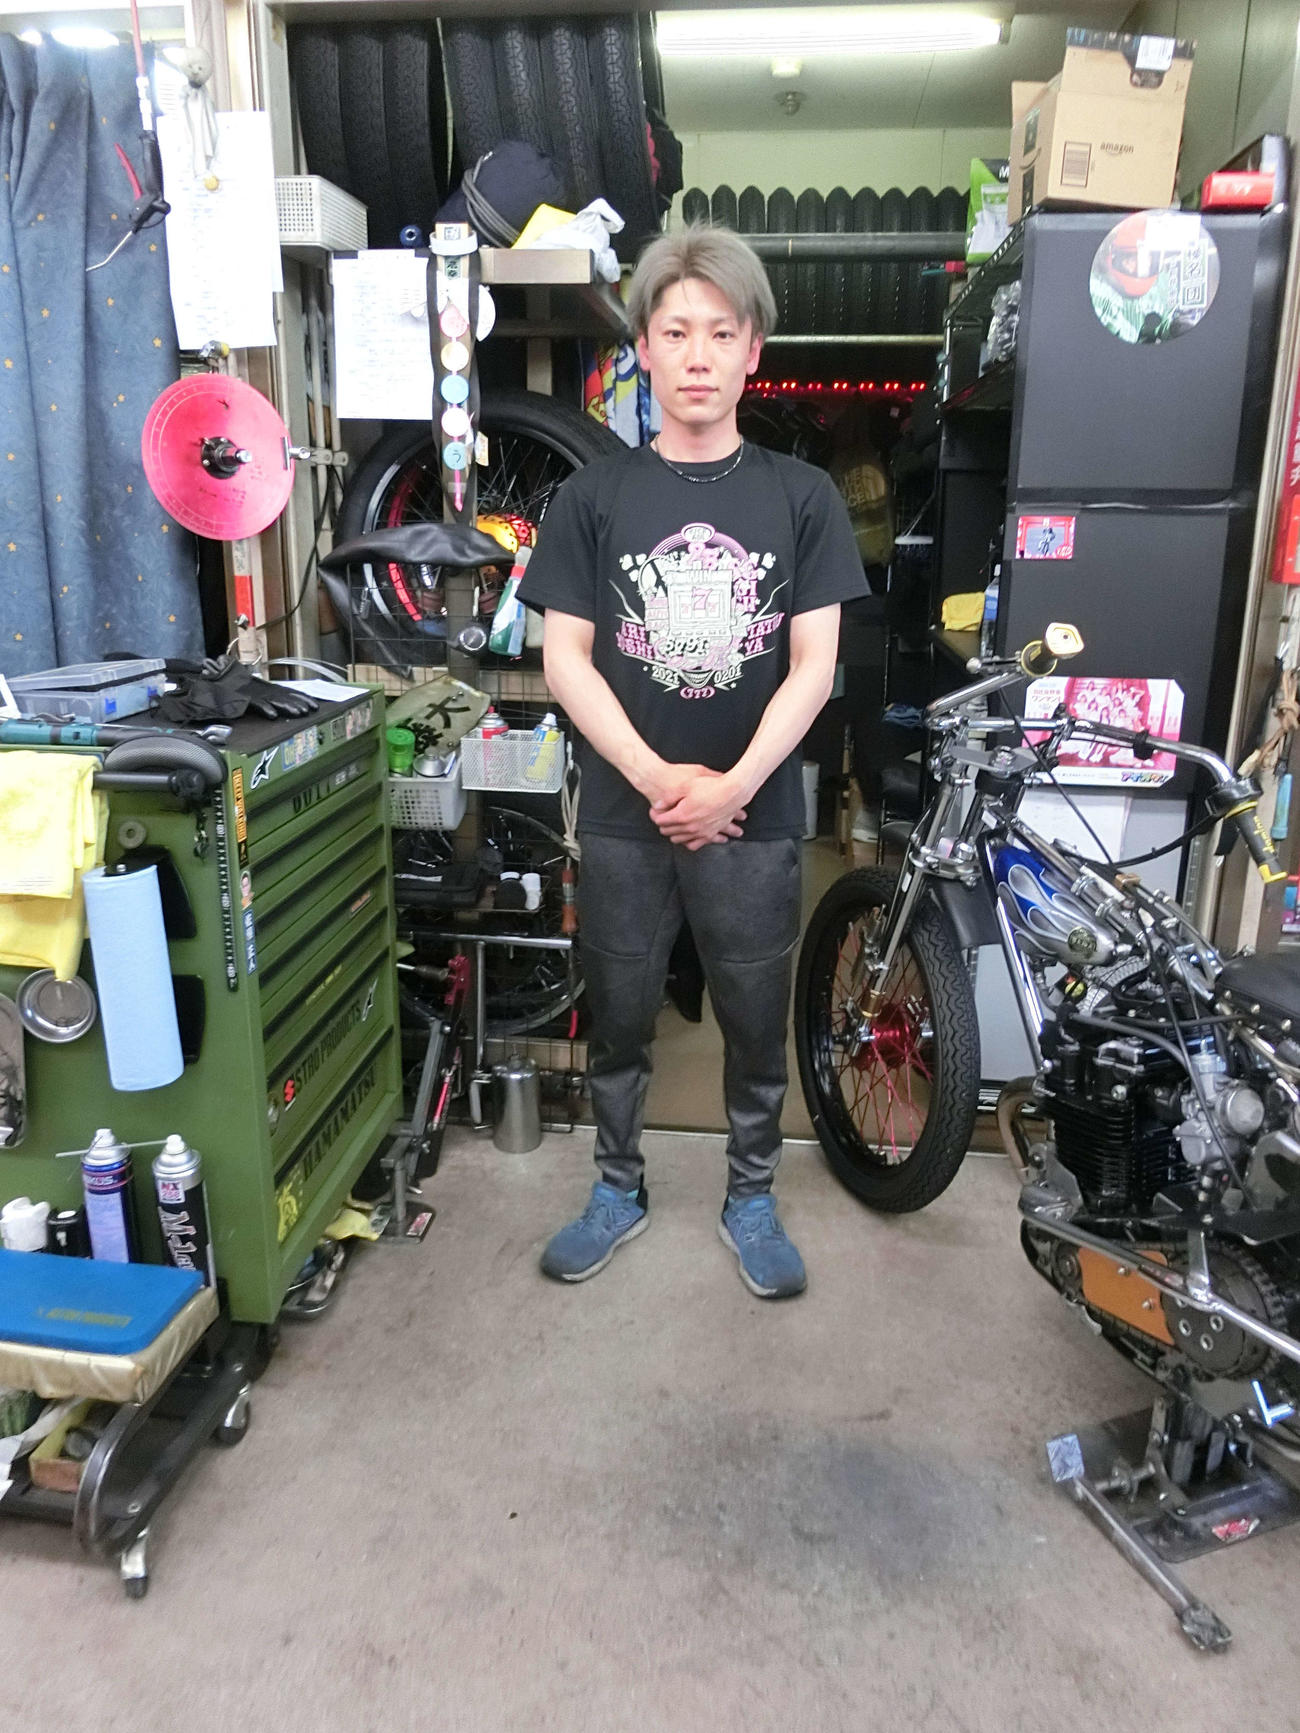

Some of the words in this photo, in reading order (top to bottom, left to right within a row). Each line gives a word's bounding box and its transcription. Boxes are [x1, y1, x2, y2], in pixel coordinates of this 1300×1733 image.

[1100, 142, 1134, 153] amazon
[692, 586, 712, 610] 7
[651, 665, 680, 685] 2021
[713, 663, 743, 684] 0201
